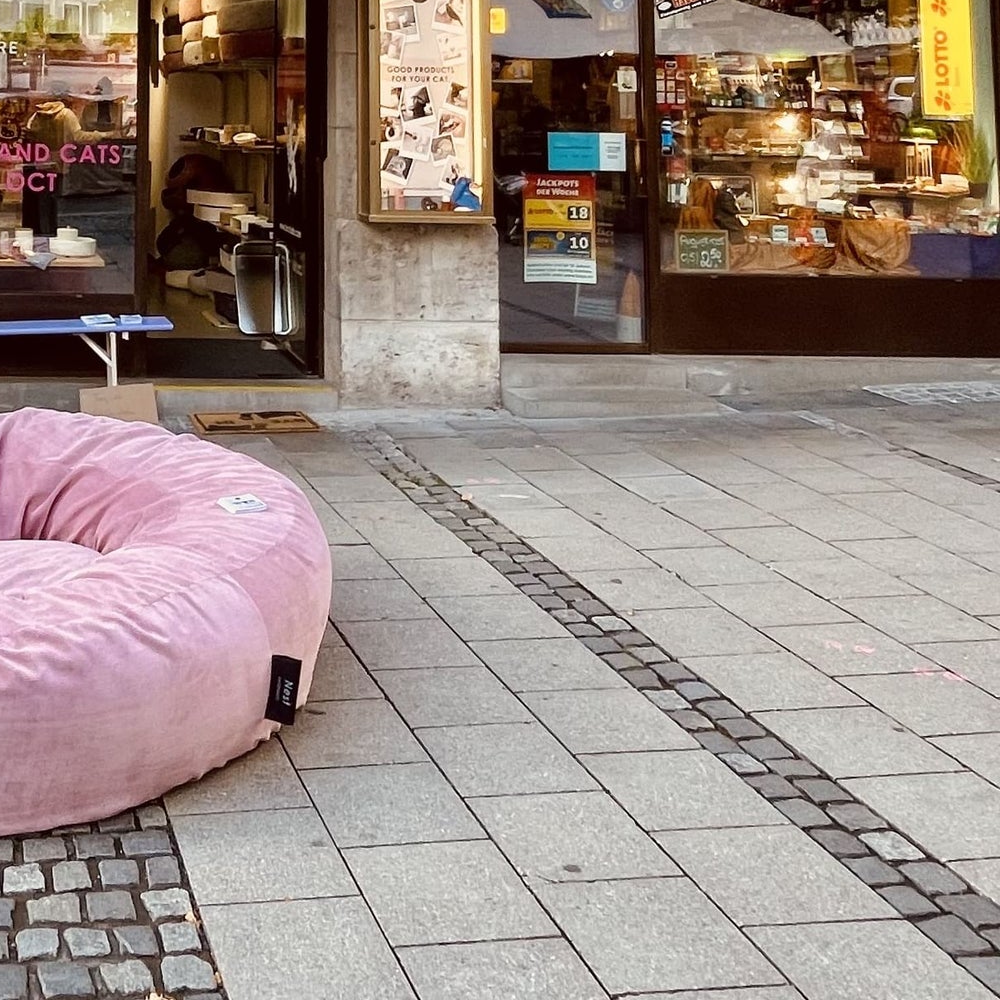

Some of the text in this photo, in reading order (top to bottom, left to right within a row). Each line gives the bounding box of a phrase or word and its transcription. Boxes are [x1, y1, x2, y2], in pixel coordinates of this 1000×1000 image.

[934, 29, 950, 87] LOTTO
[60, 143, 121, 164] CATS
[569, 206, 589, 219] 18
[569, 236, 589, 249] 10
